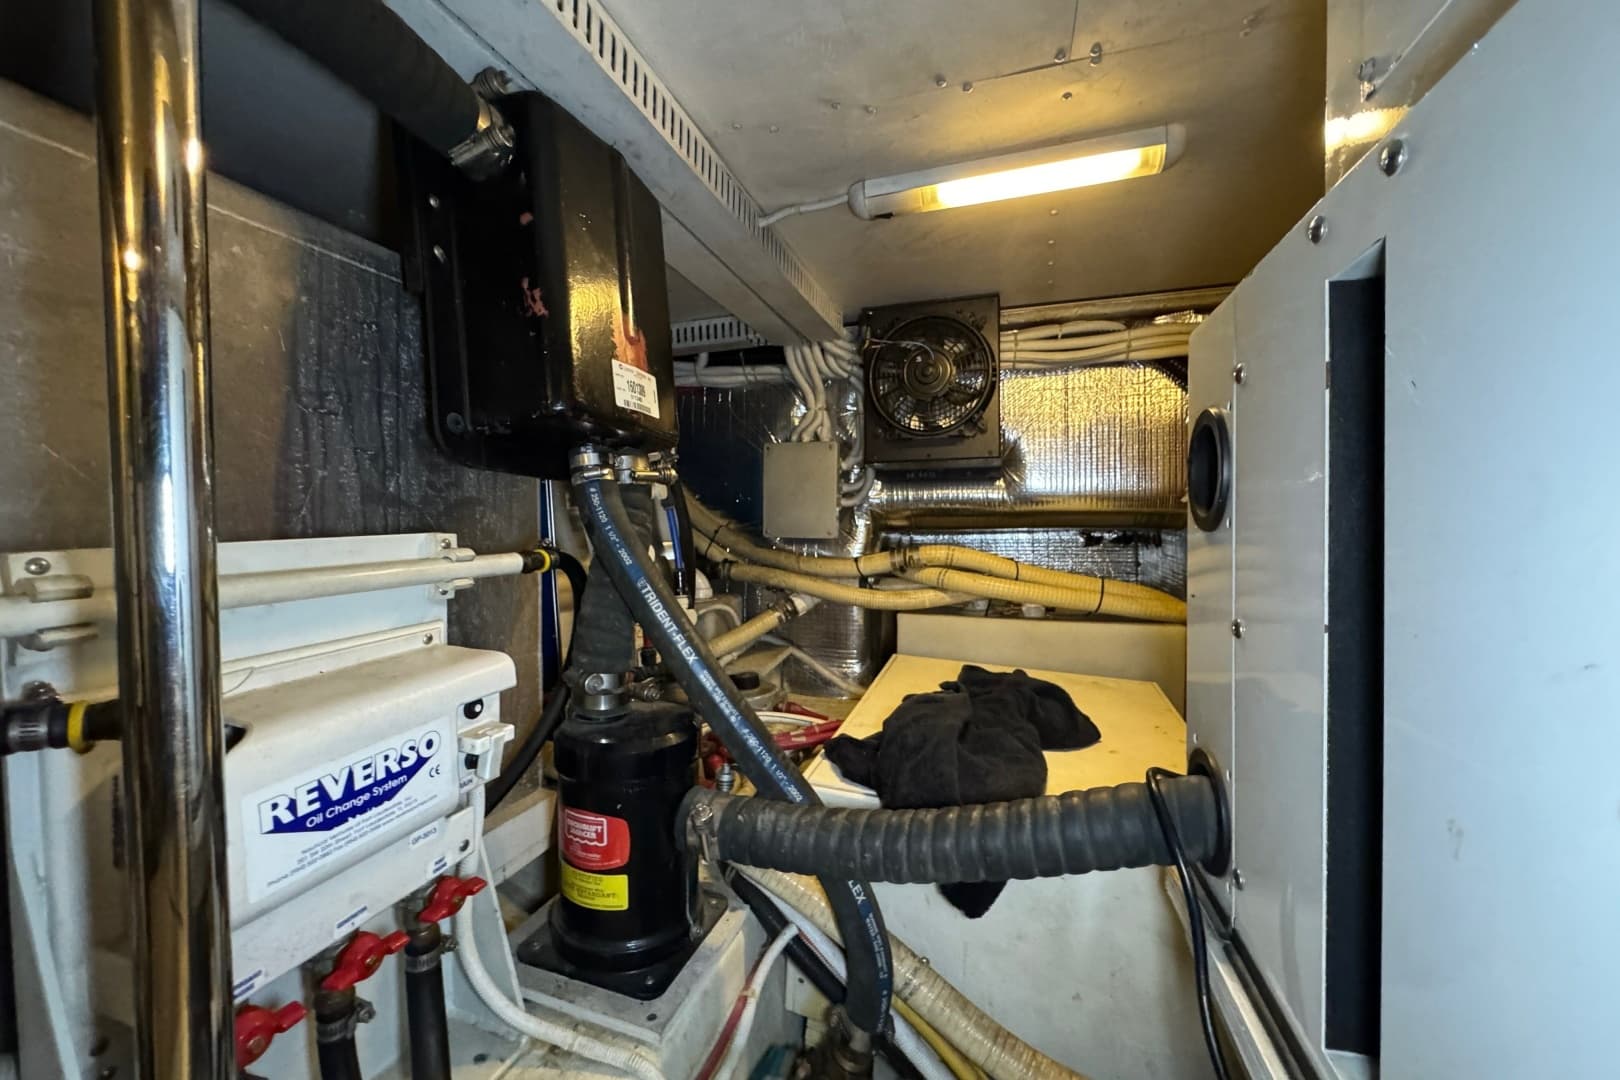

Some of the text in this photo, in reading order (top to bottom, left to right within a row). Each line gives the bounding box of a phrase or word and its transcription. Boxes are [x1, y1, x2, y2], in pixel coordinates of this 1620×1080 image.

[590, 493, 608, 524] 250-1120
[639, 582, 699, 669] TRIDENT-FLEX
[258, 730, 441, 834] REVERSO
[306, 775, 408, 828] Oil Change System
